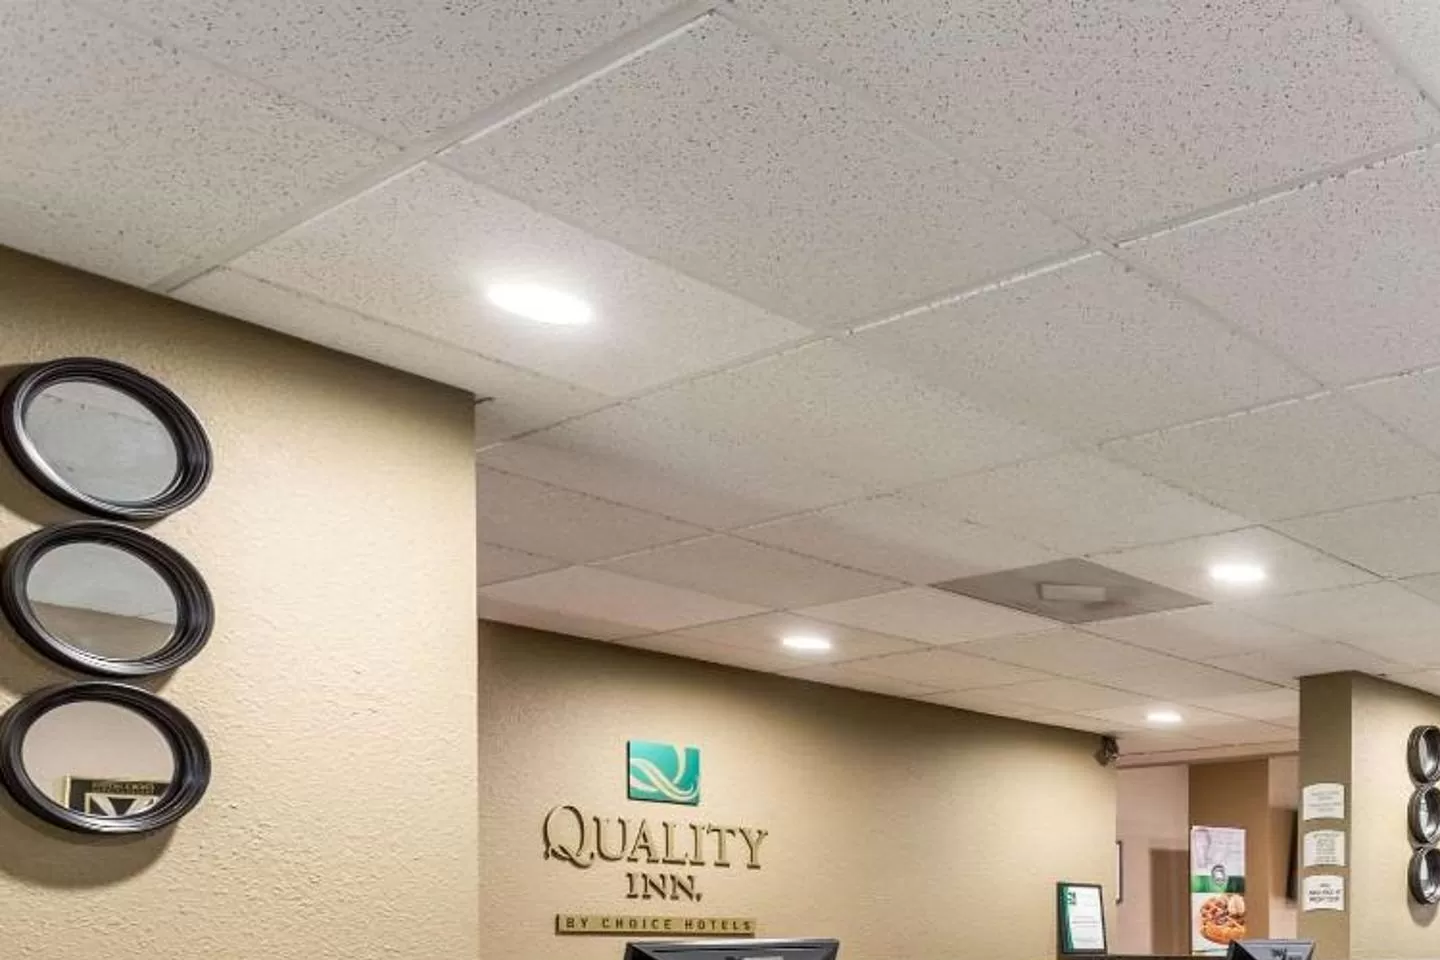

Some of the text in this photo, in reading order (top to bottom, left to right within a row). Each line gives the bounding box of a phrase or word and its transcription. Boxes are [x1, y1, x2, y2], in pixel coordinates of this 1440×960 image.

[543, 805, 769, 870] QUALITY
[566, 918, 752, 931] BY CHOICE HOTELS
